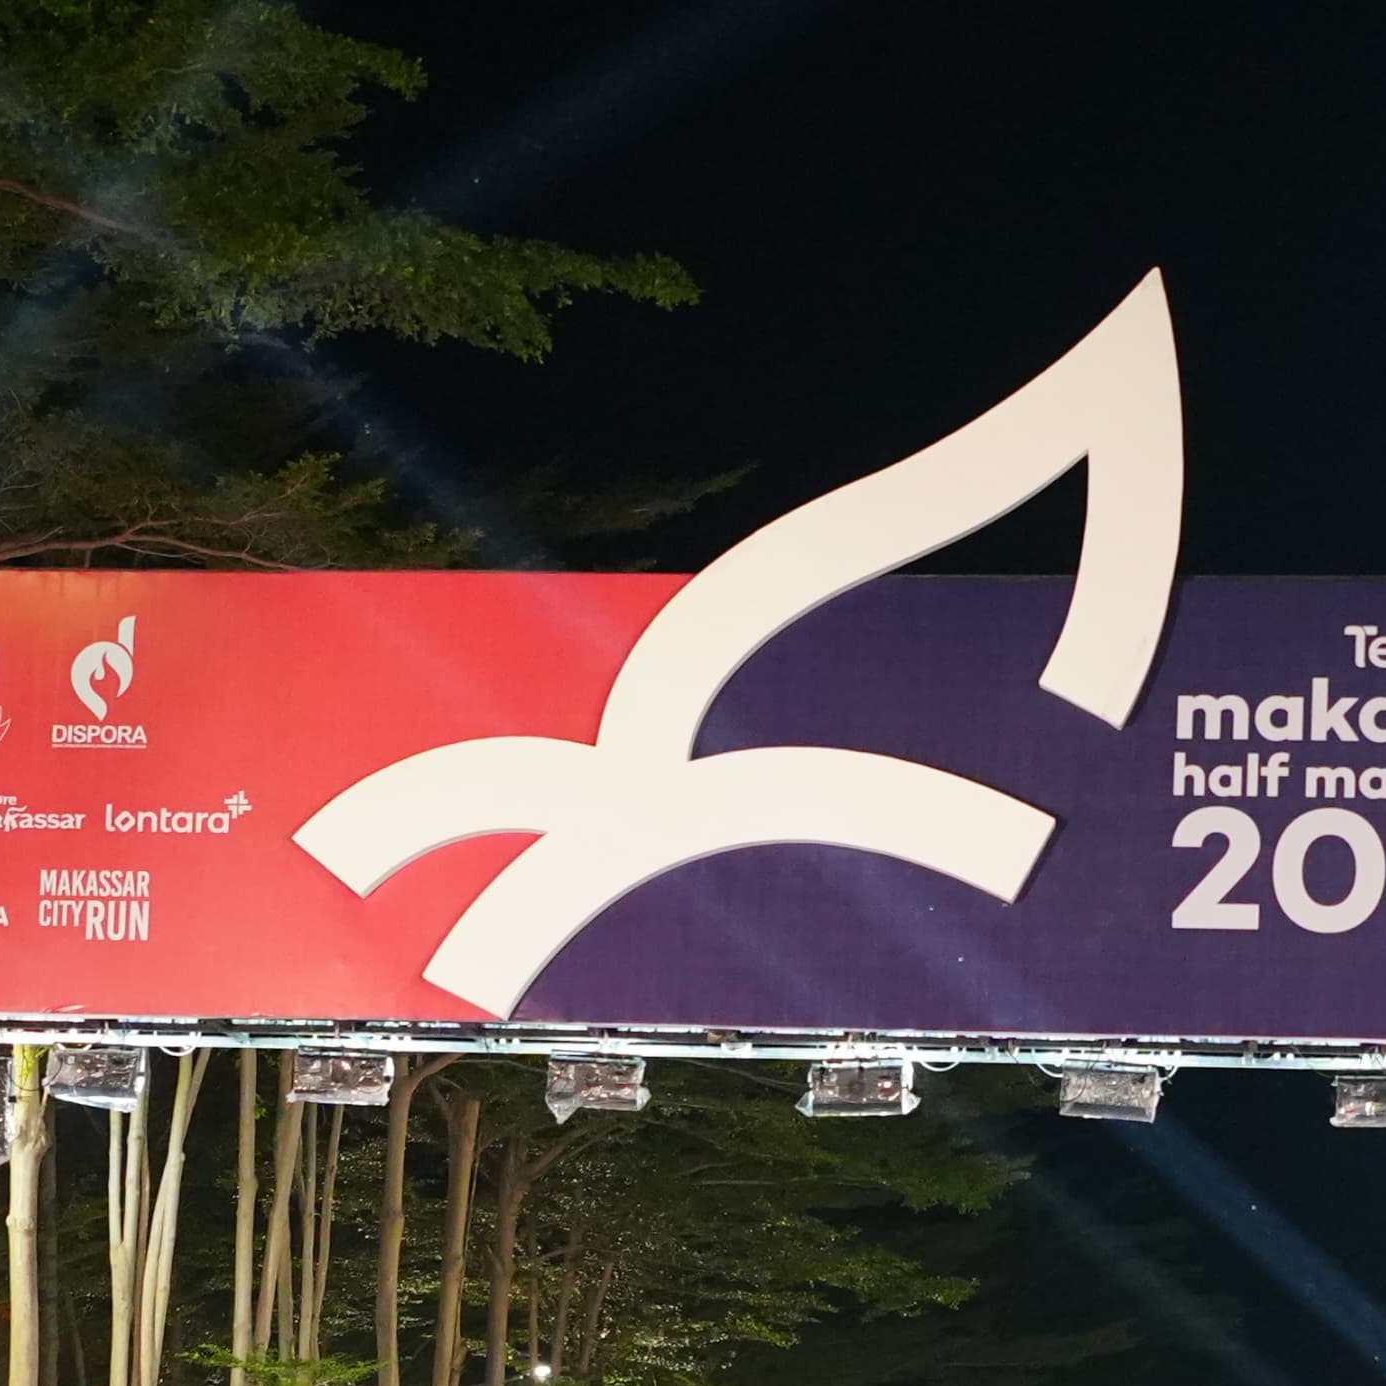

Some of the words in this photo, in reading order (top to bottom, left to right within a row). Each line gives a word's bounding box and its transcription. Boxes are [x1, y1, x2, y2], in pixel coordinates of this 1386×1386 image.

[51, 724, 148, 744] DISPORA
[1172, 752, 1290, 798] half
[40, 869, 150, 898] MAKASSAR
[38, 900, 84, 928] CITY
[86, 901, 150, 941] RUN
